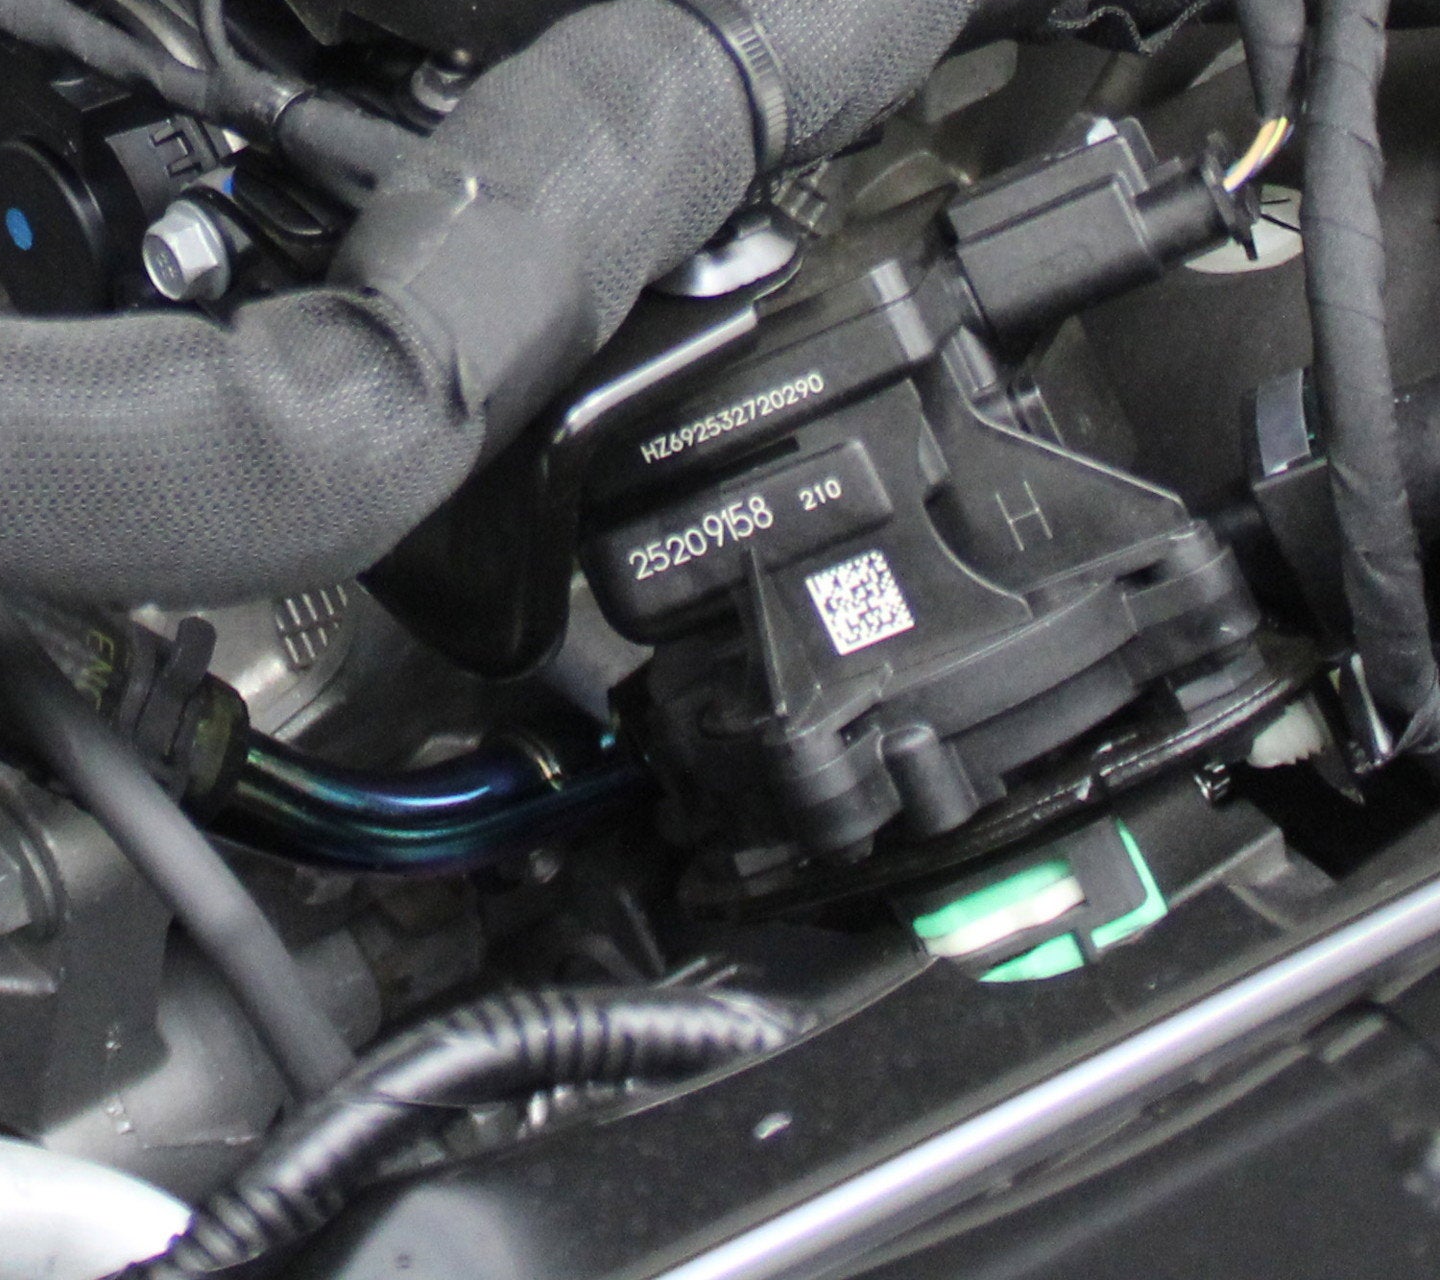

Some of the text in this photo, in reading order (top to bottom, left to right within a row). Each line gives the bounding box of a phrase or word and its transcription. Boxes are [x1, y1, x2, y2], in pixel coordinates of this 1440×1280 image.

[640, 372, 825, 465] HZ692532720290
[629, 478, 843, 581] 25209158 210
